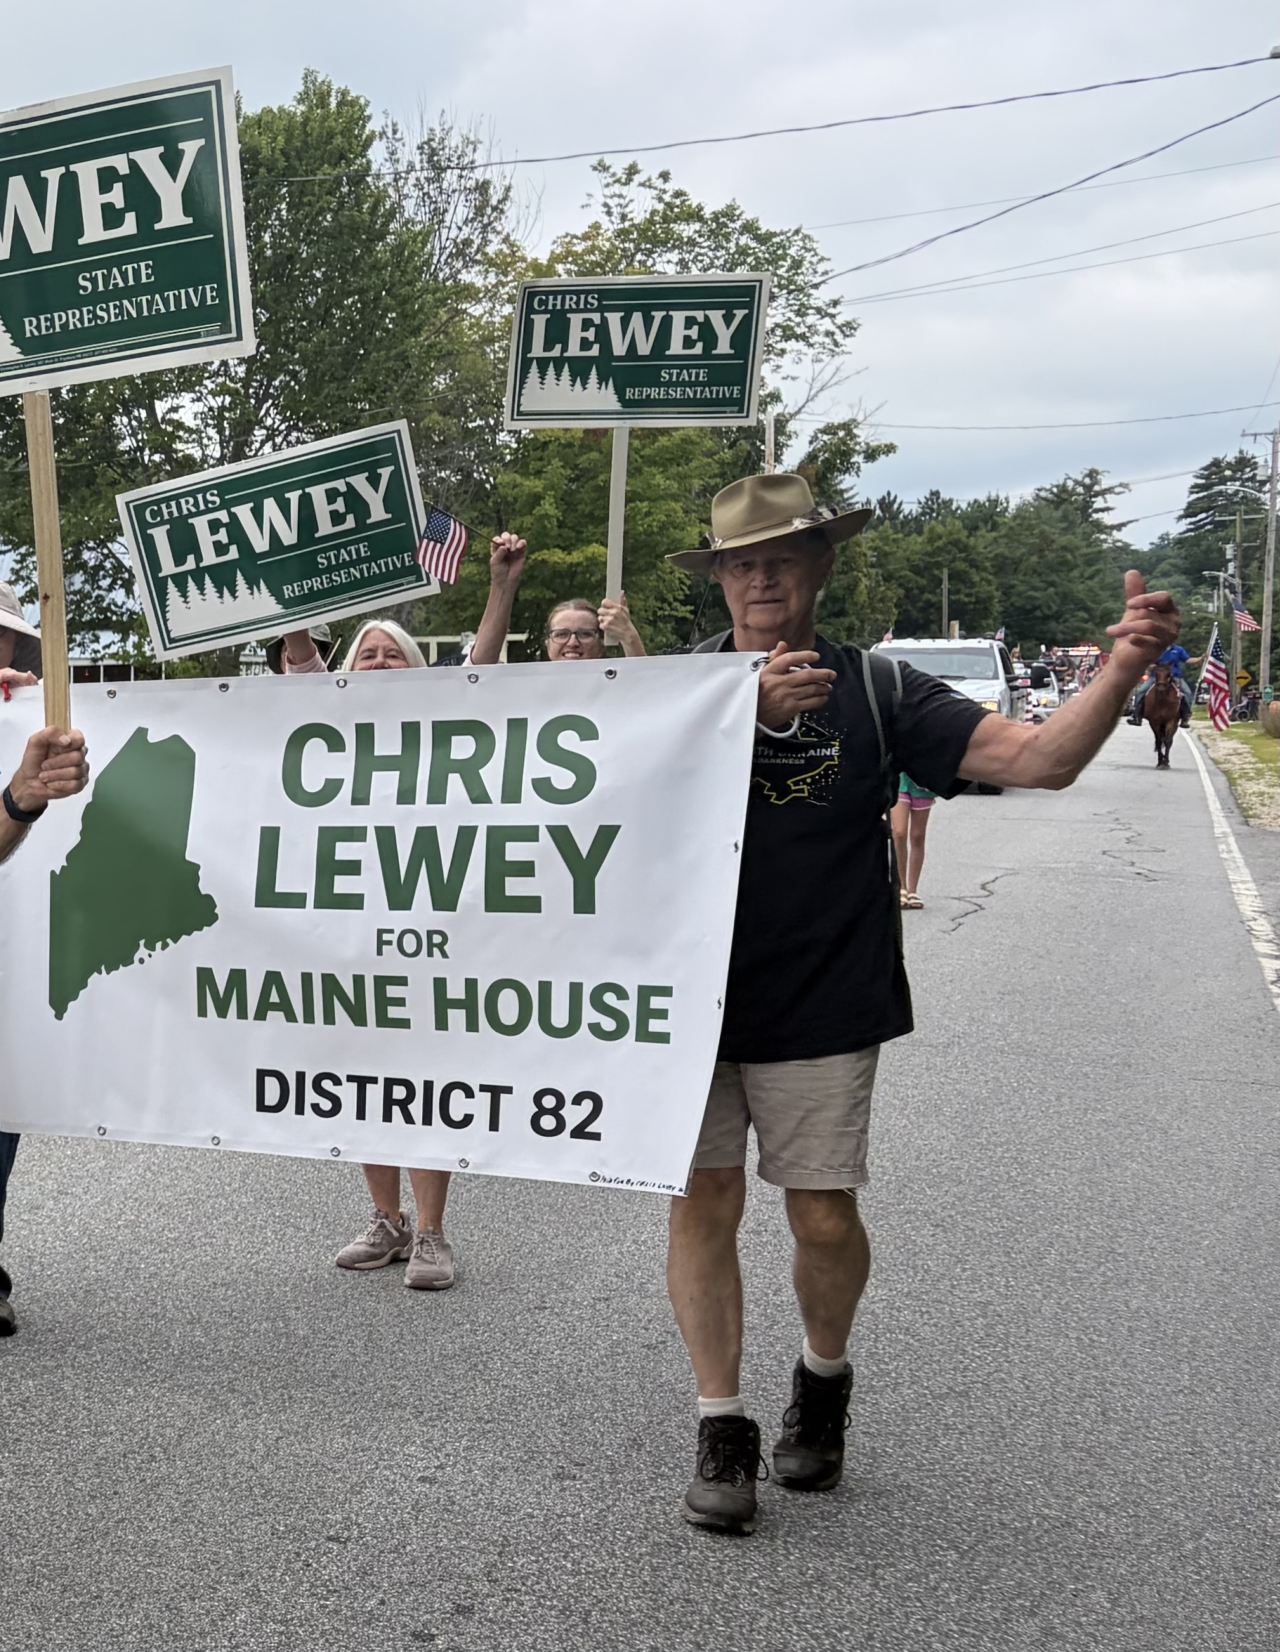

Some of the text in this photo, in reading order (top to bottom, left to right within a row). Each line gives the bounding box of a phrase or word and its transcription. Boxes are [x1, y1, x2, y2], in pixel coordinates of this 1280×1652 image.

[78, 260, 155, 295] STATE
[23, 284, 220, 338] REPRESENTATIVE
[533, 294, 599, 310] CHRIS
[527, 309, 749, 358] LEWEY
[625, 386, 741, 400] REPRESENTATIVE
[660, 369, 708, 382] STATE
[145, 489, 221, 524] CHRIS
[147, 465, 395, 577] LEWEY
[282, 552, 414, 599] REPRESENTATIVE
[317, 542, 370, 569] STATE
[281, 714, 600, 808] CHRIS
[254, 824, 622, 915] LEWEY
[376, 928, 450, 959] FOR
[195, 966, 673, 1045] MAINE HOUSE
[255, 1068, 604, 1142] DISTRICT 82
